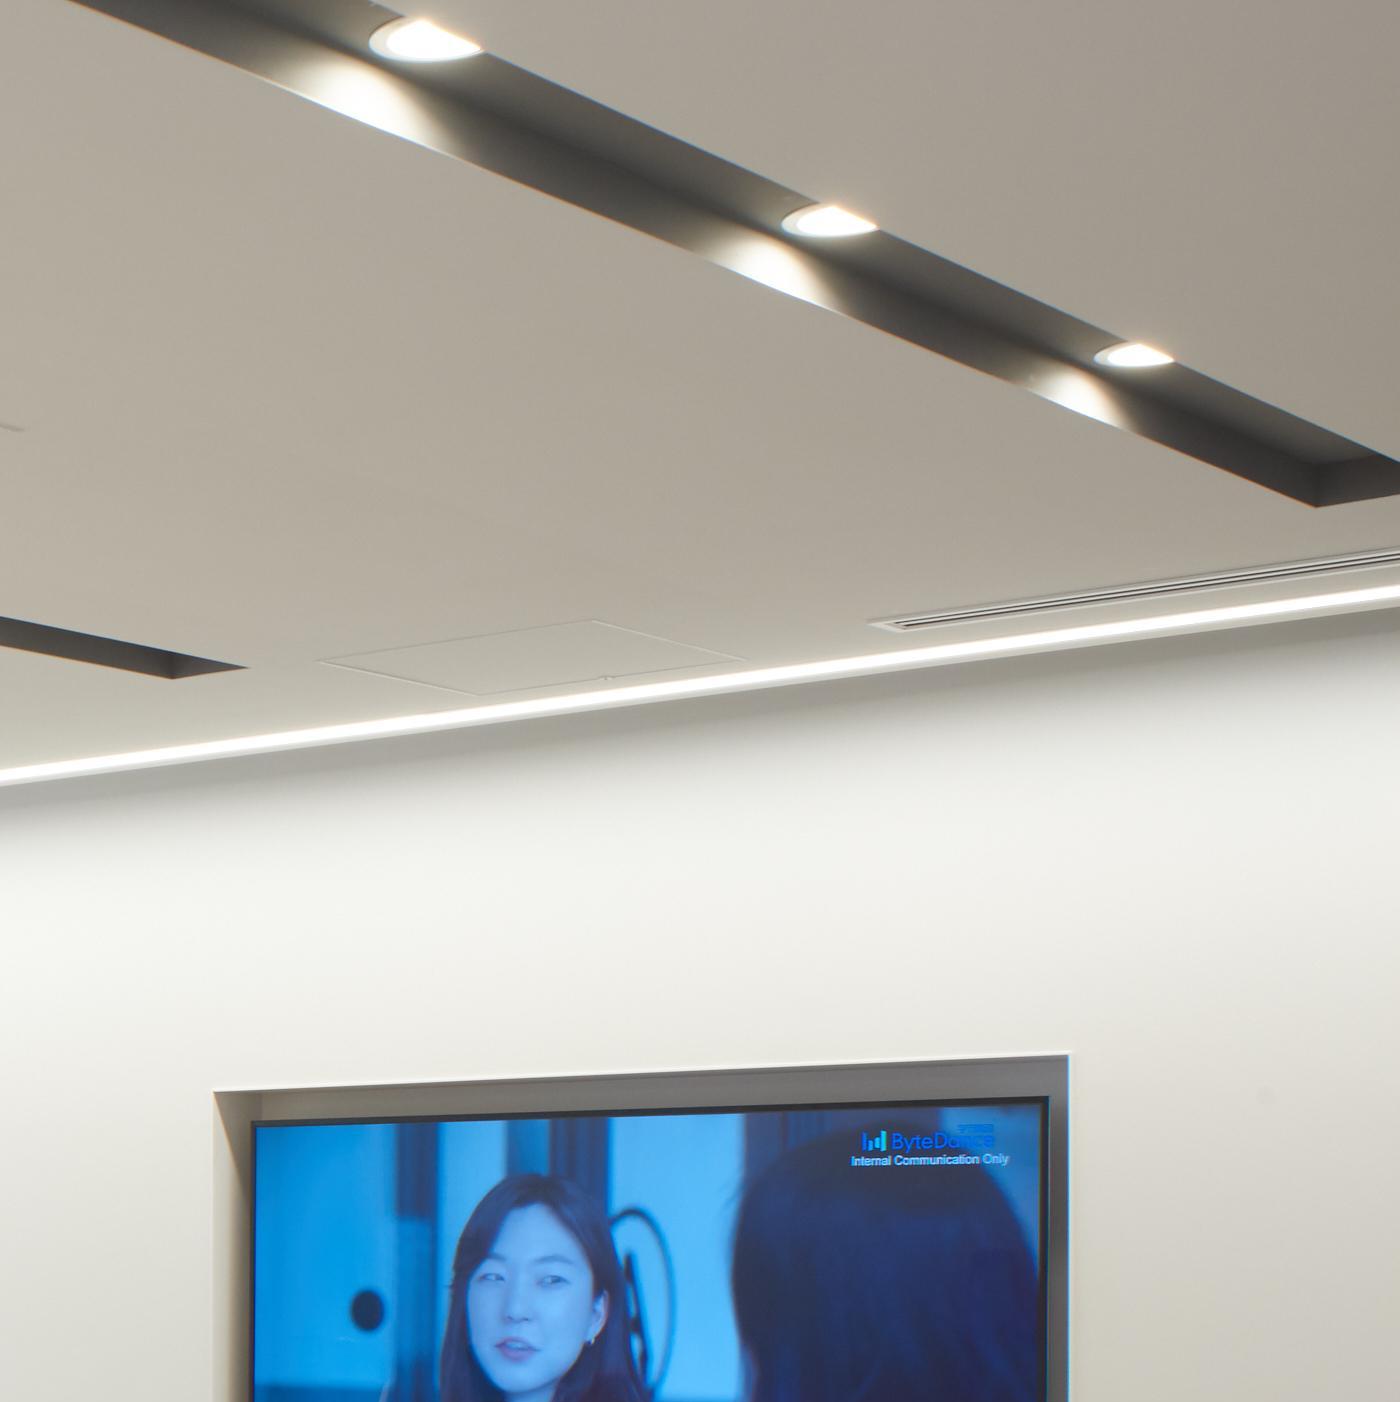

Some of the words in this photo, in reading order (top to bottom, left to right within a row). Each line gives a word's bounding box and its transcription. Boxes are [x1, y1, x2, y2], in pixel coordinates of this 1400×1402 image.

[892, 1132, 996, 1153] ByteDance
[851, 1155, 891, 1167] Internal
[893, 1153, 980, 1166] Communication
[982, 1153, 1010, 1167] Only
